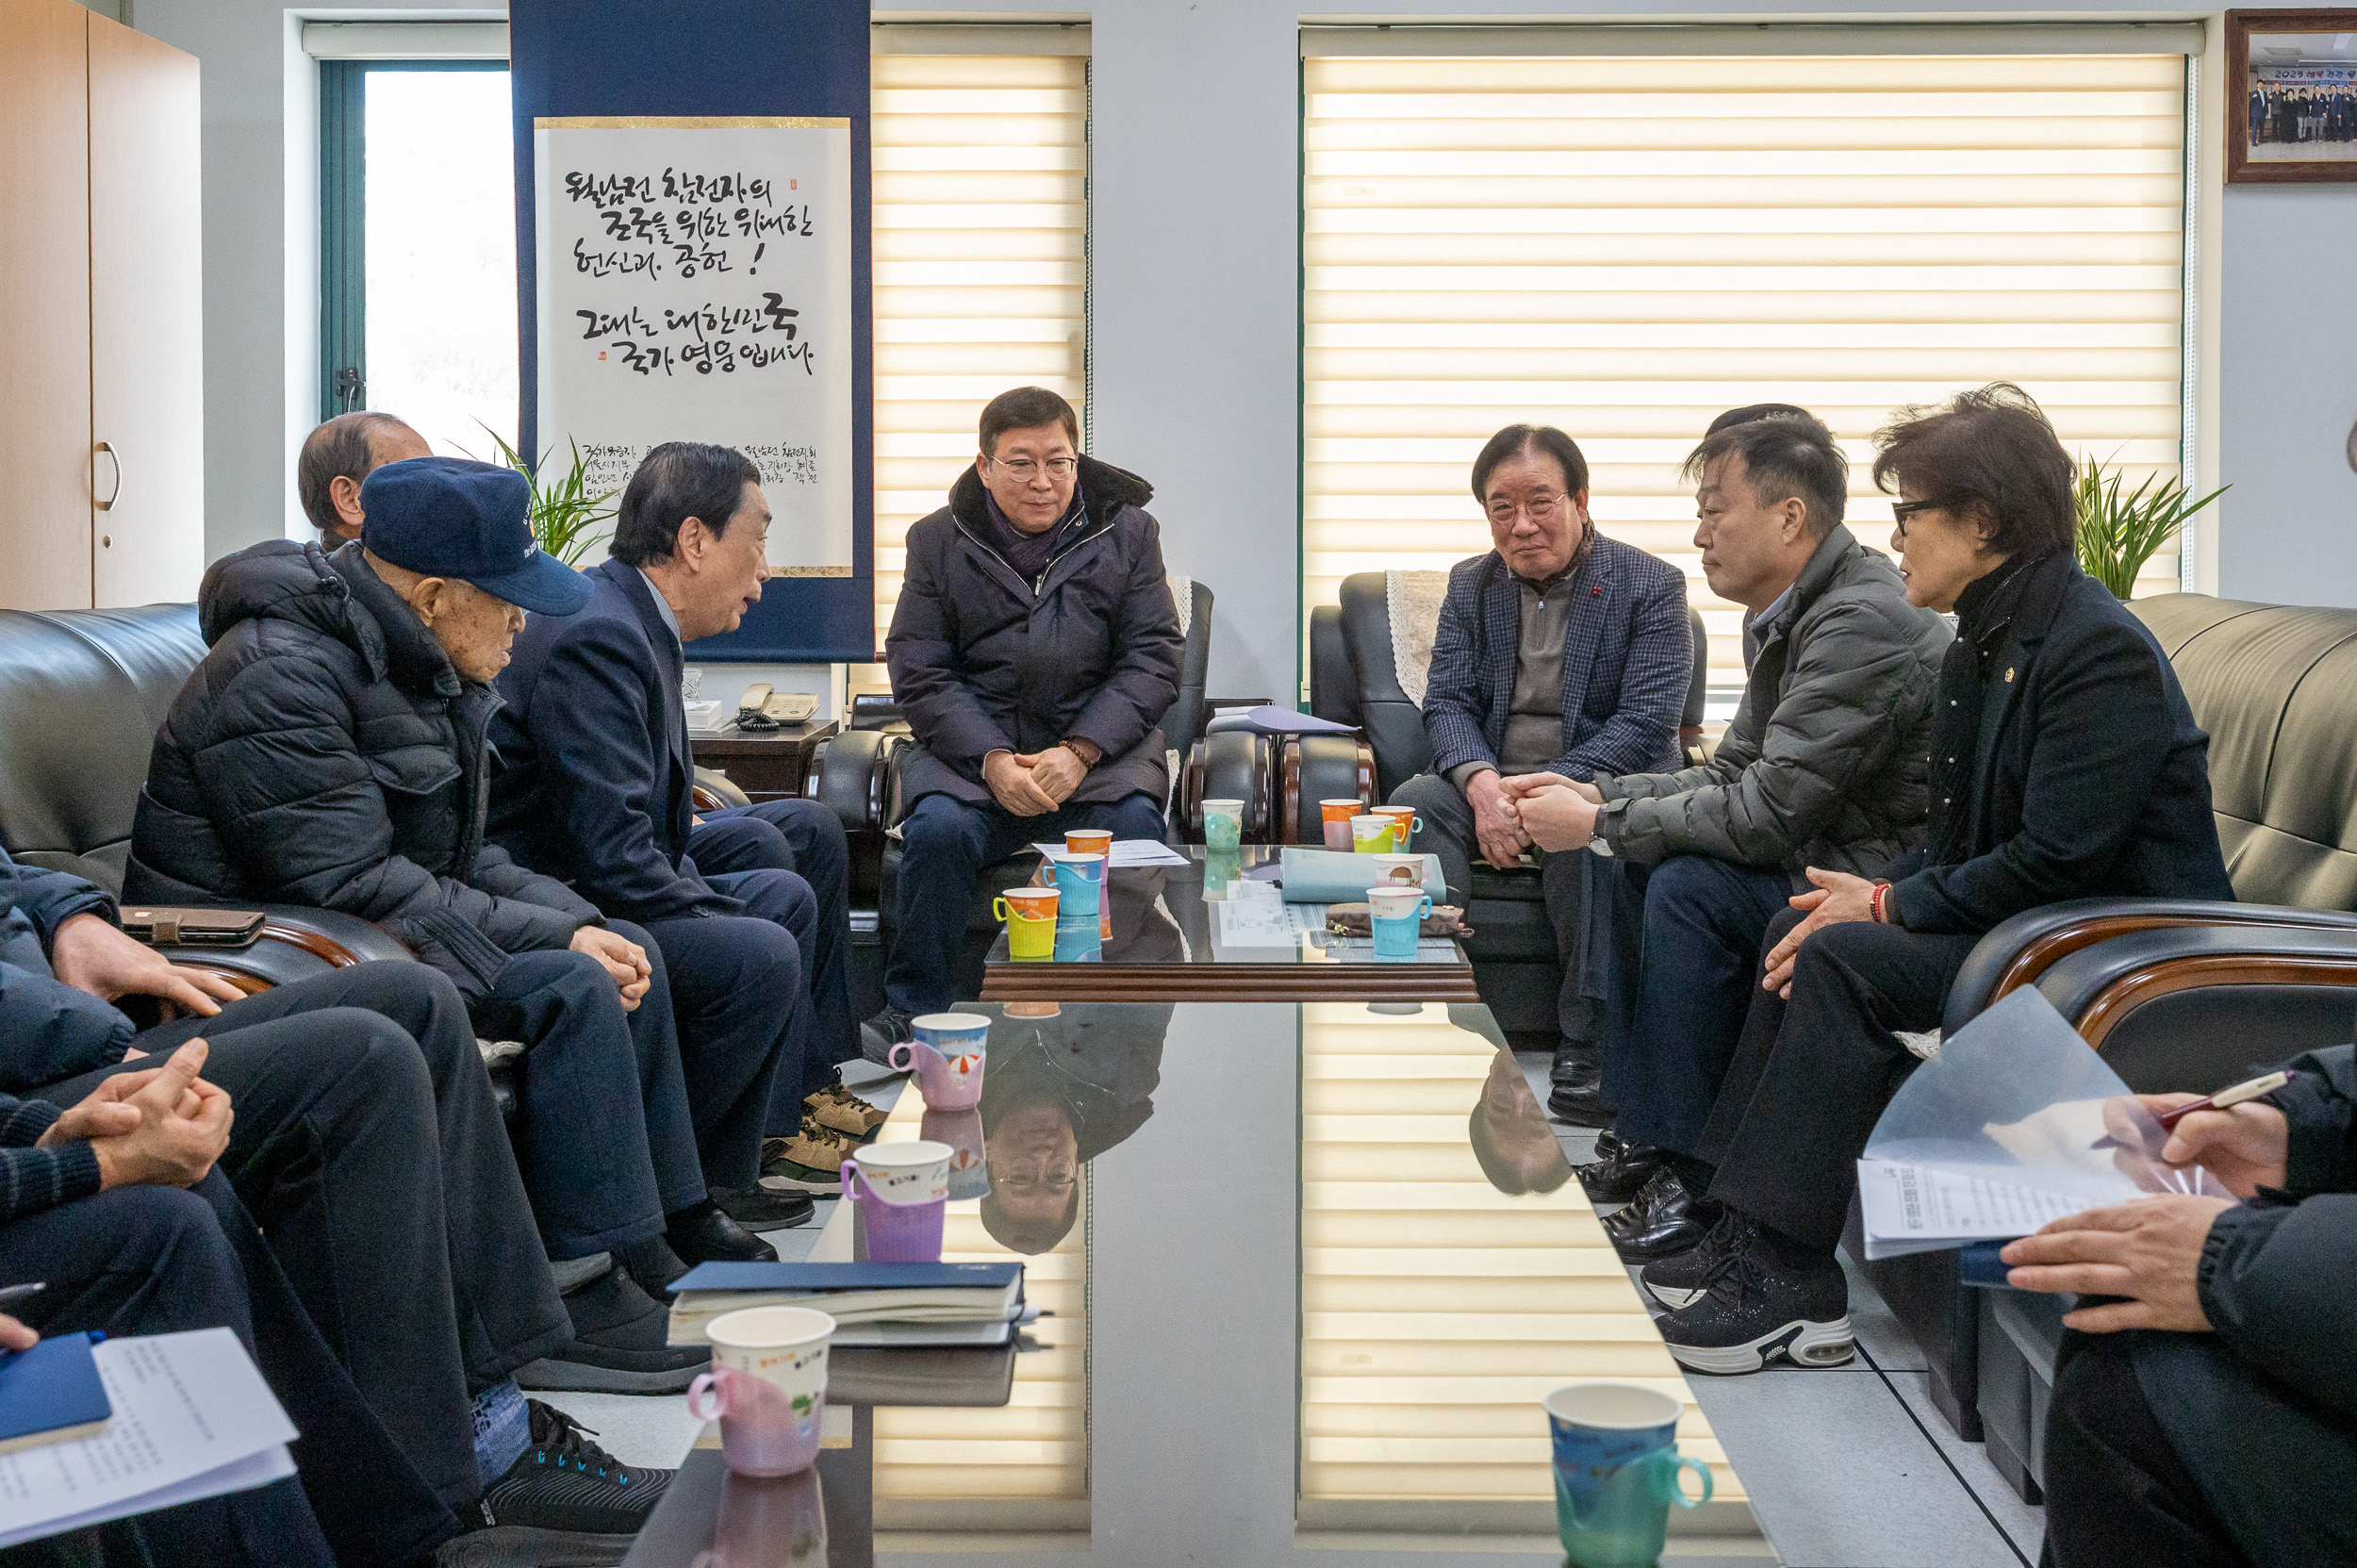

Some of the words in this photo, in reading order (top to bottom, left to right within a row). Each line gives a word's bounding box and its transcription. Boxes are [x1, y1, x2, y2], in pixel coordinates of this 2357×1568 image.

[566, 172, 656, 208] 월남전
[601, 207, 674, 244] 조국을
[676, 207, 730, 242] 위한
[734, 206, 814, 238] 위대한
[574, 238, 662, 281] 헌신과
[576, 306, 658, 338] 그대는
[665, 292, 799, 342] 대한민국
